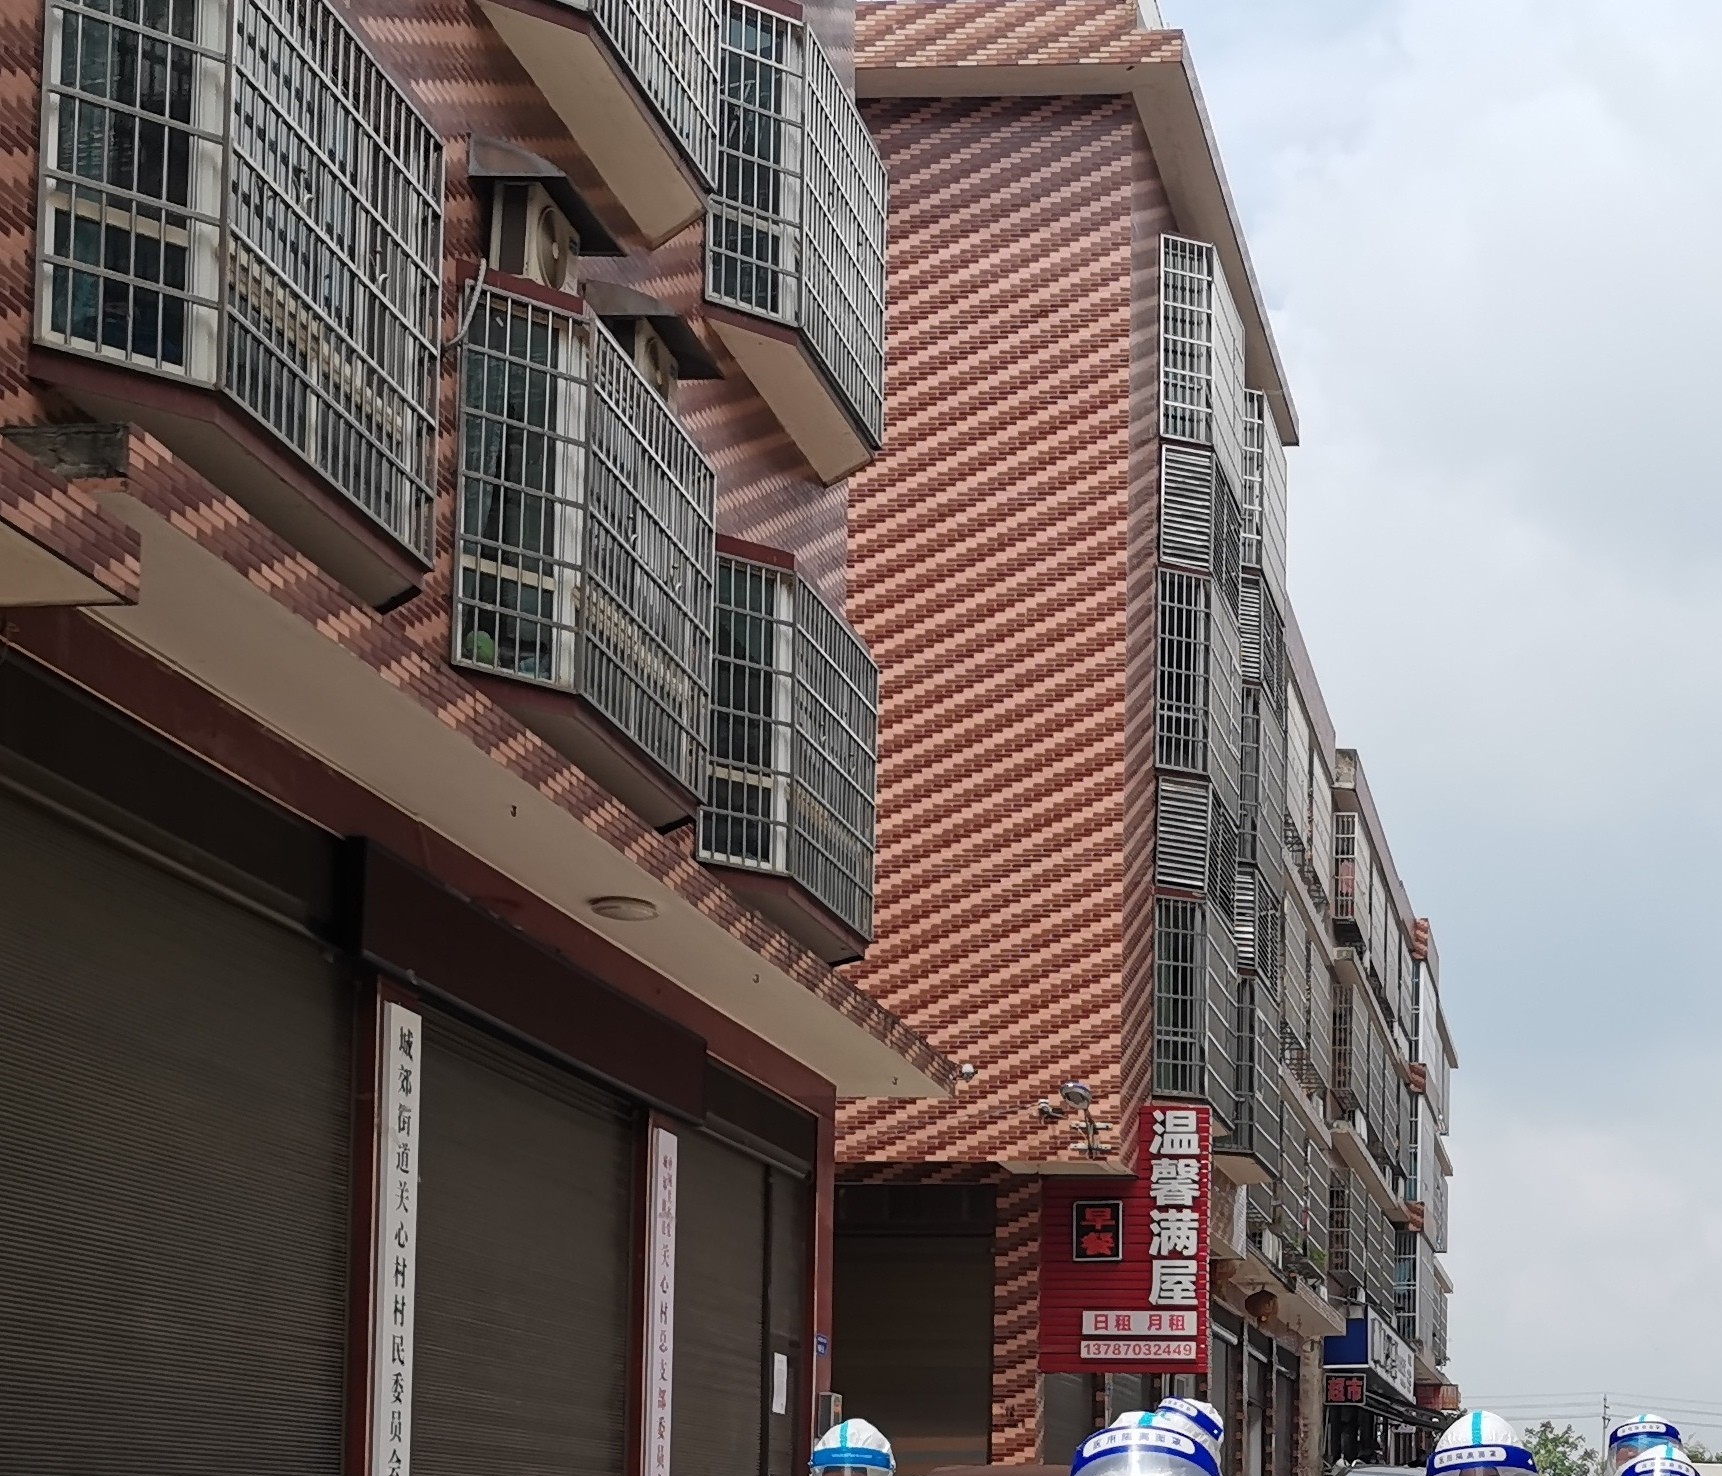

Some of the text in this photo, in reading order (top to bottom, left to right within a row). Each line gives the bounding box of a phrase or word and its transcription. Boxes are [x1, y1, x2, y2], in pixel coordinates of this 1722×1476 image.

[1148, 1108, 1201, 1307] 温馨满屋
[1080, 1207, 1115, 1256] 早餐
[1094, 1314, 1186, 1332] 日租 月租
[1083, 1343, 1192, 1356] 13787032449
[1327, 1377, 1364, 1402] 超市
